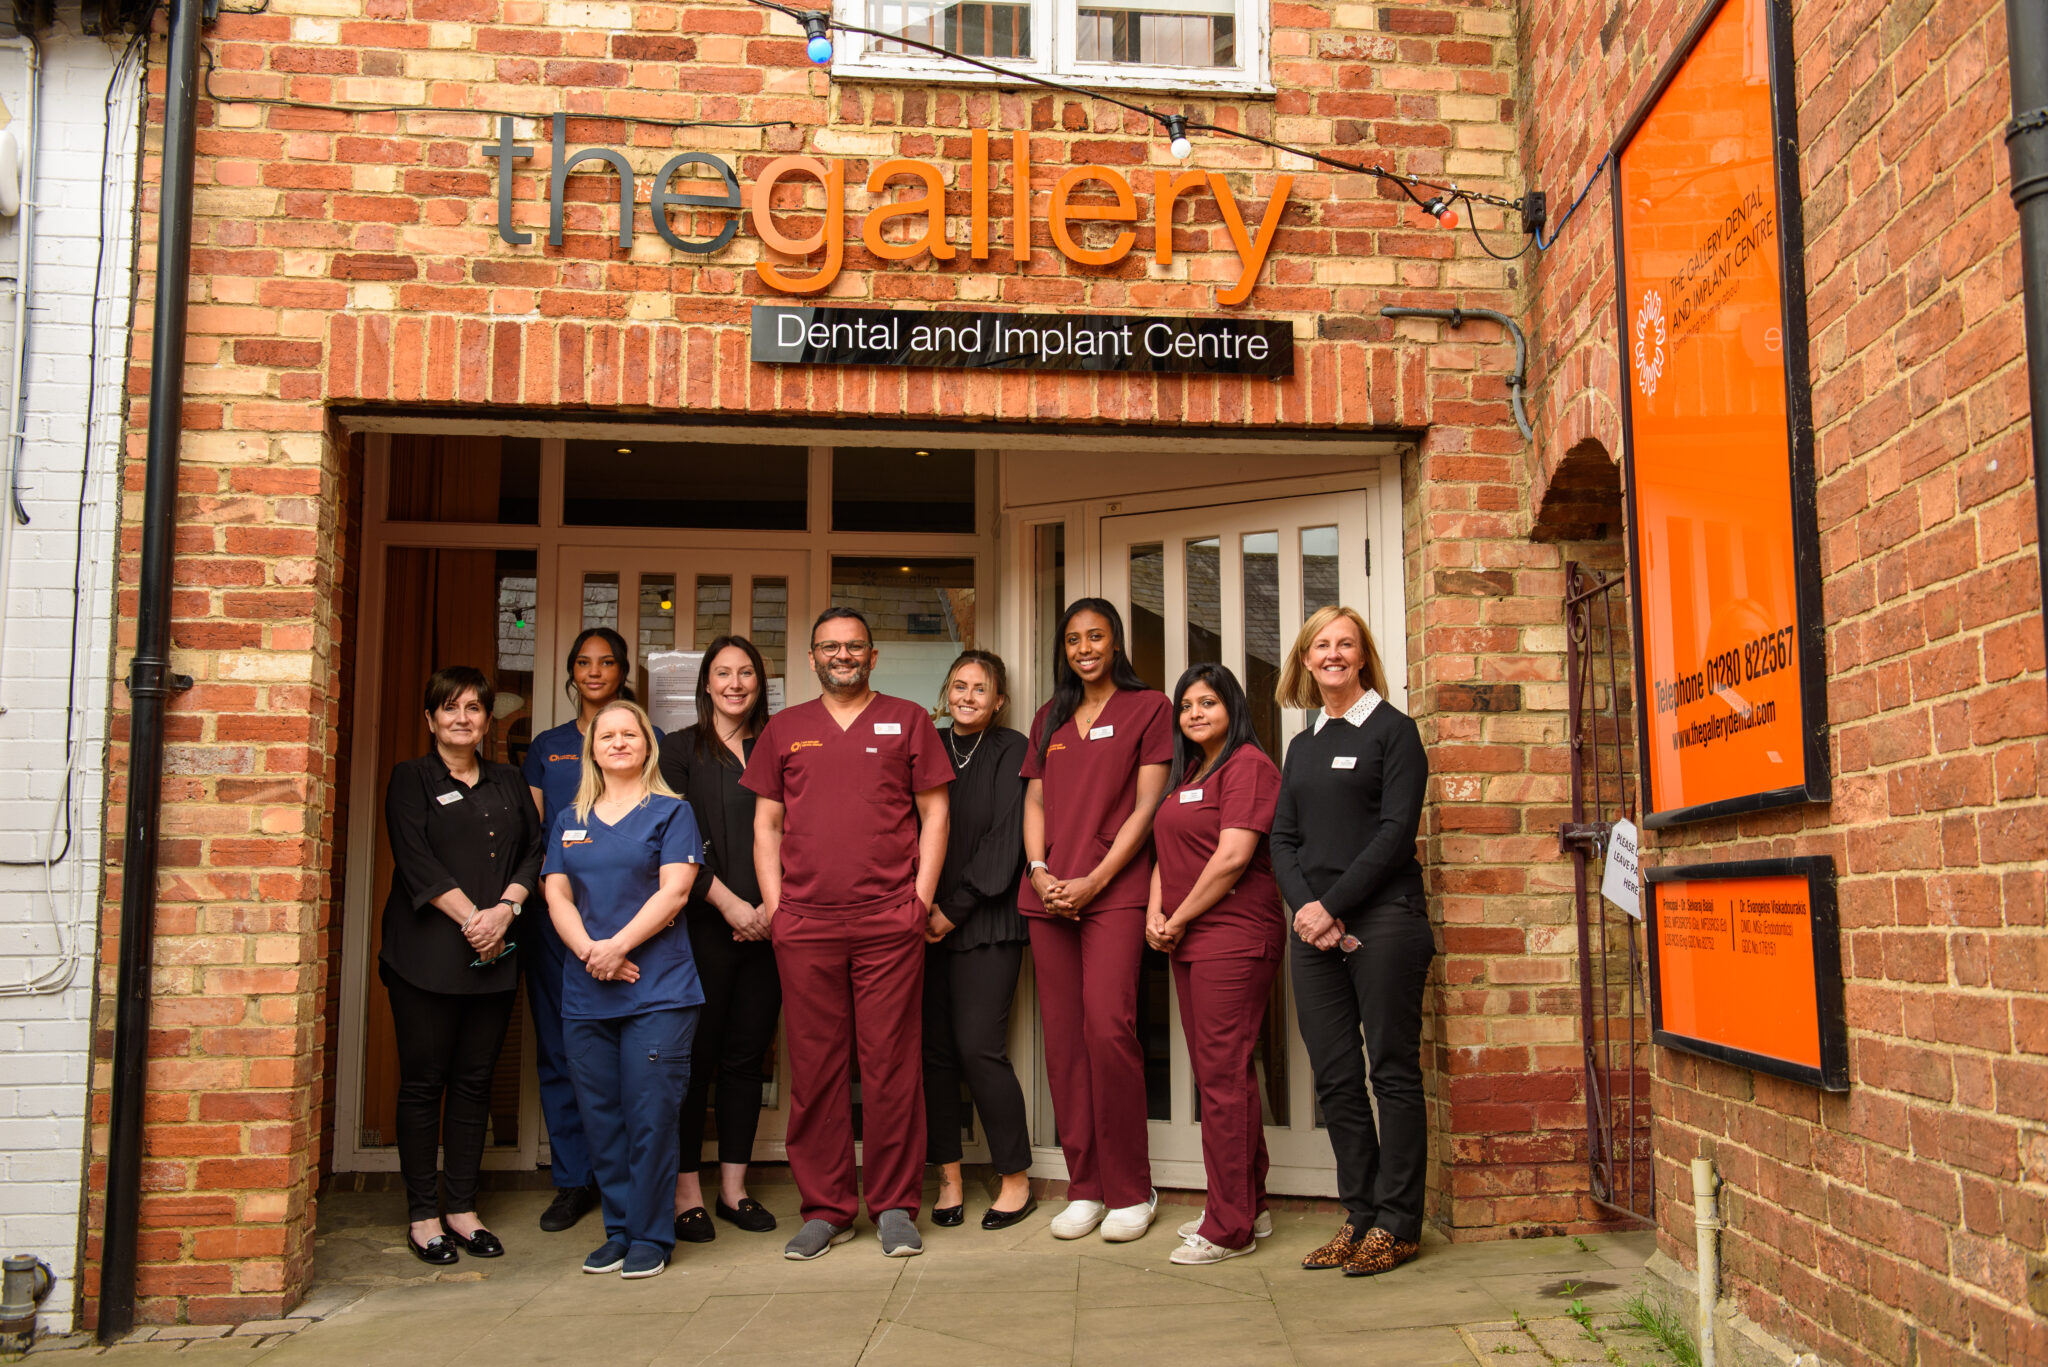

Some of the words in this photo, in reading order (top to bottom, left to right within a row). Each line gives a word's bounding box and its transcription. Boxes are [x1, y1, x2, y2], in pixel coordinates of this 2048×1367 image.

[1670, 268, 1685, 300] THE
[1687, 224, 1723, 282] GALLERY
[1725, 184, 1764, 242] DENTAL
[1672, 298, 1691, 335] AND
[1693, 252, 1732, 312] IMPLANT
[1734, 210, 1773, 268] CENTRE
[1721, 279, 1741, 305] about
[777, 313, 898, 351] Dental
[910, 321, 981, 353] and
[994, 321, 1133, 362] Implant
[1144, 322, 1269, 361] Centre
[1655, 671, 1704, 717] Telephone
[1706, 648, 1741, 696] 01280
[1744, 625, 1794, 682] 822567
[1672, 700, 1776, 751] www.thegallerydental.com
[1613, 849, 1630, 871] LEAVE
[1616, 833, 1635, 855] PLEASE
[1623, 877, 1639, 896] HERE
[1747, 899, 1770, 917] Evangelos
